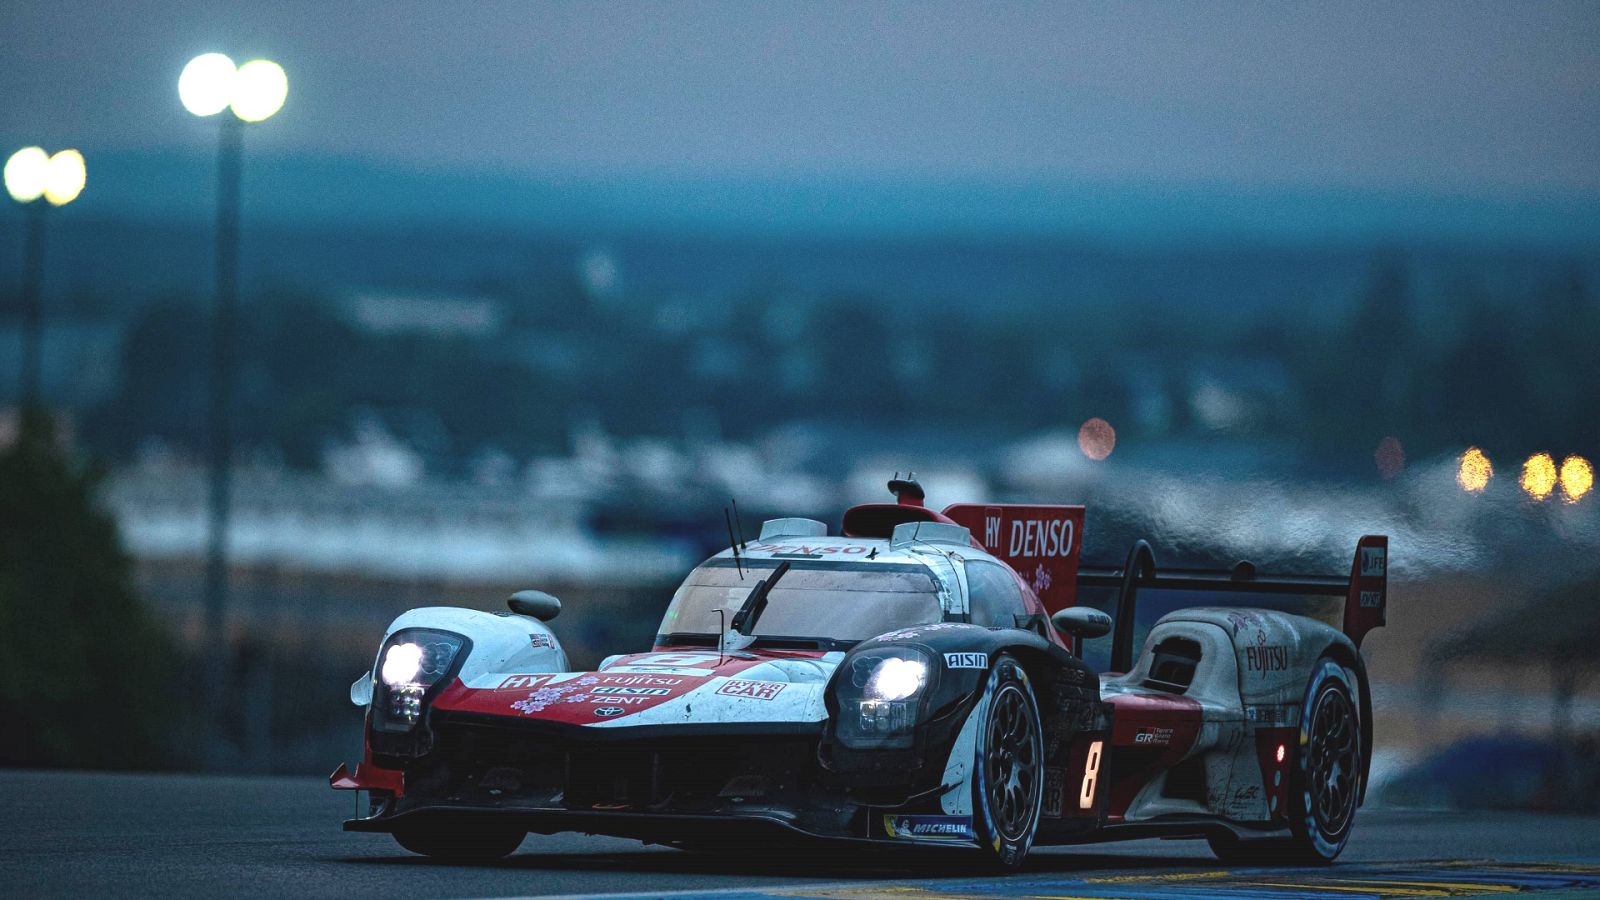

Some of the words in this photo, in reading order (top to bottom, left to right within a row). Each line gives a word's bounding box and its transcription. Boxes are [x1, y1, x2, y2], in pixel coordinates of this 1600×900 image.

[985, 516, 1001, 548] HY
[1009, 519, 1073, 557] DENSO
[948, 654, 987, 667] AISIN
[1246, 645, 1288, 679] FUJITSU
[500, 675, 550, 689] HY
[603, 675, 683, 686] FUJITSU
[728, 680, 780, 690] HYPER
[722, 684, 773, 699] CAR
[590, 696, 650, 705] ZENT
[1135, 733, 1153, 743] GR
[1079, 741, 1103, 809] 8
[913, 823, 967, 833] MICHELIN
